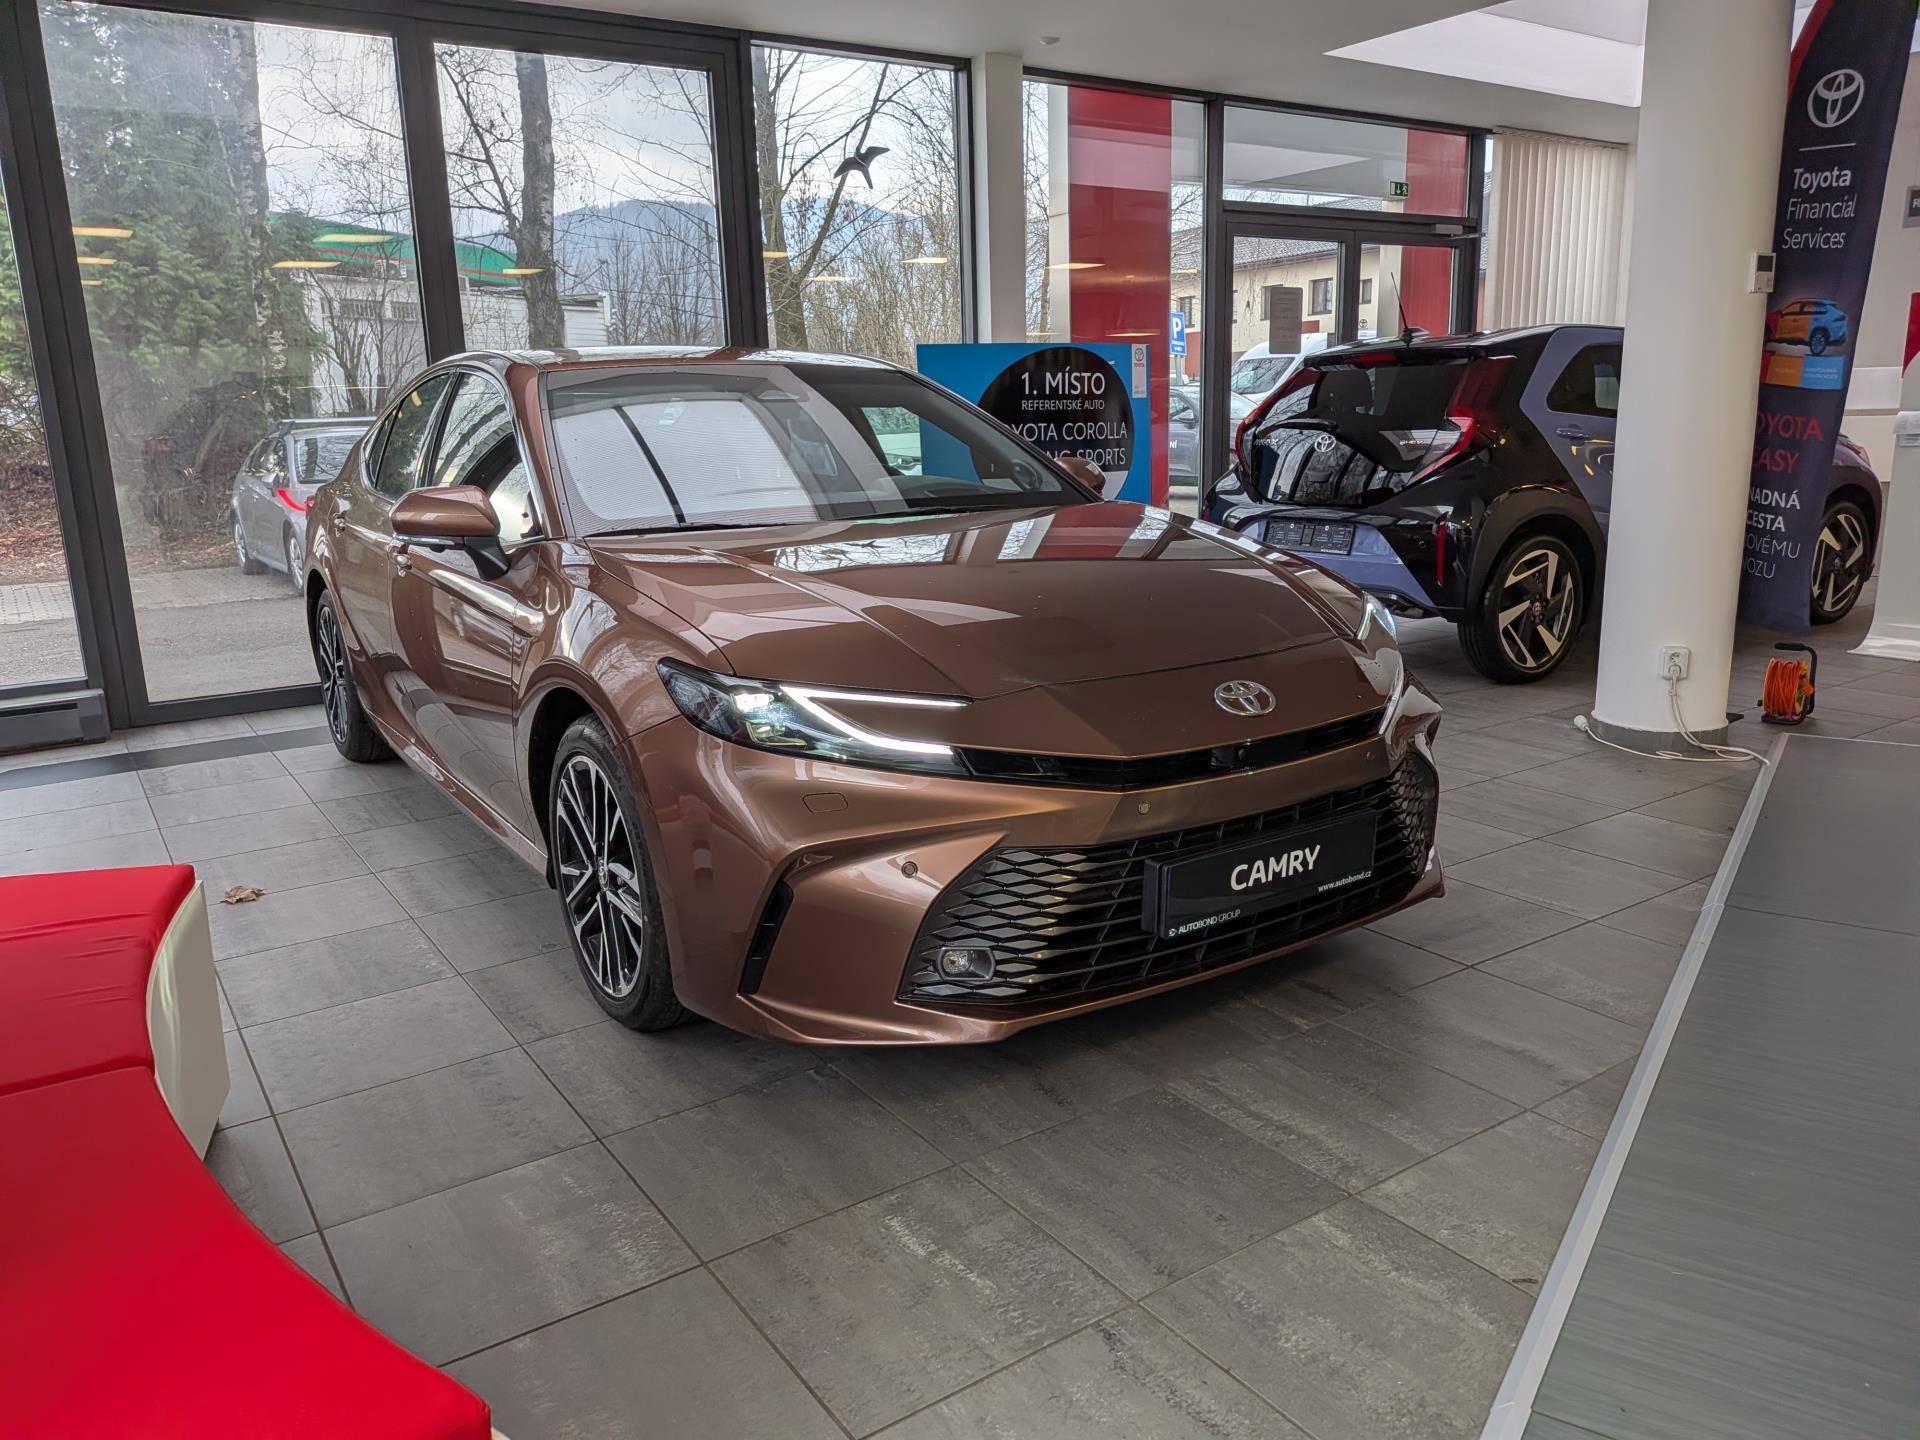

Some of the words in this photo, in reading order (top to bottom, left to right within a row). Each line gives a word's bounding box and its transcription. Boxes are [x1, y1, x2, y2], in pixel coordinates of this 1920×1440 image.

[1793, 166, 1852, 194] Toyota
[1786, 194, 1858, 220] Financial
[1781, 227, 1847, 249] Services
[1172, 317, 1182, 339] P
[1021, 372, 1037, 395] 1.
[1045, 366, 1106, 395] MÍSTO
[1021, 397, 1082, 411] REFERENTSKÉ
[1084, 399, 1105, 410] AUTO
[1011, 423, 1058, 441] YOTA
[1062, 422, 1128, 440] COROLLA
[1757, 448, 1800, 474] ASY
[1746, 510, 1786, 533] CESTA
[1745, 533, 1801, 559] OVÉMU
[1745, 557, 1776, 579] OZU
[1230, 844, 1321, 892] CAMRY
[1318, 870, 1372, 893] www.autobond.cz
[1178, 916, 1218, 935] AUTOBOND
[1218, 909, 1241, 923] GROUP
